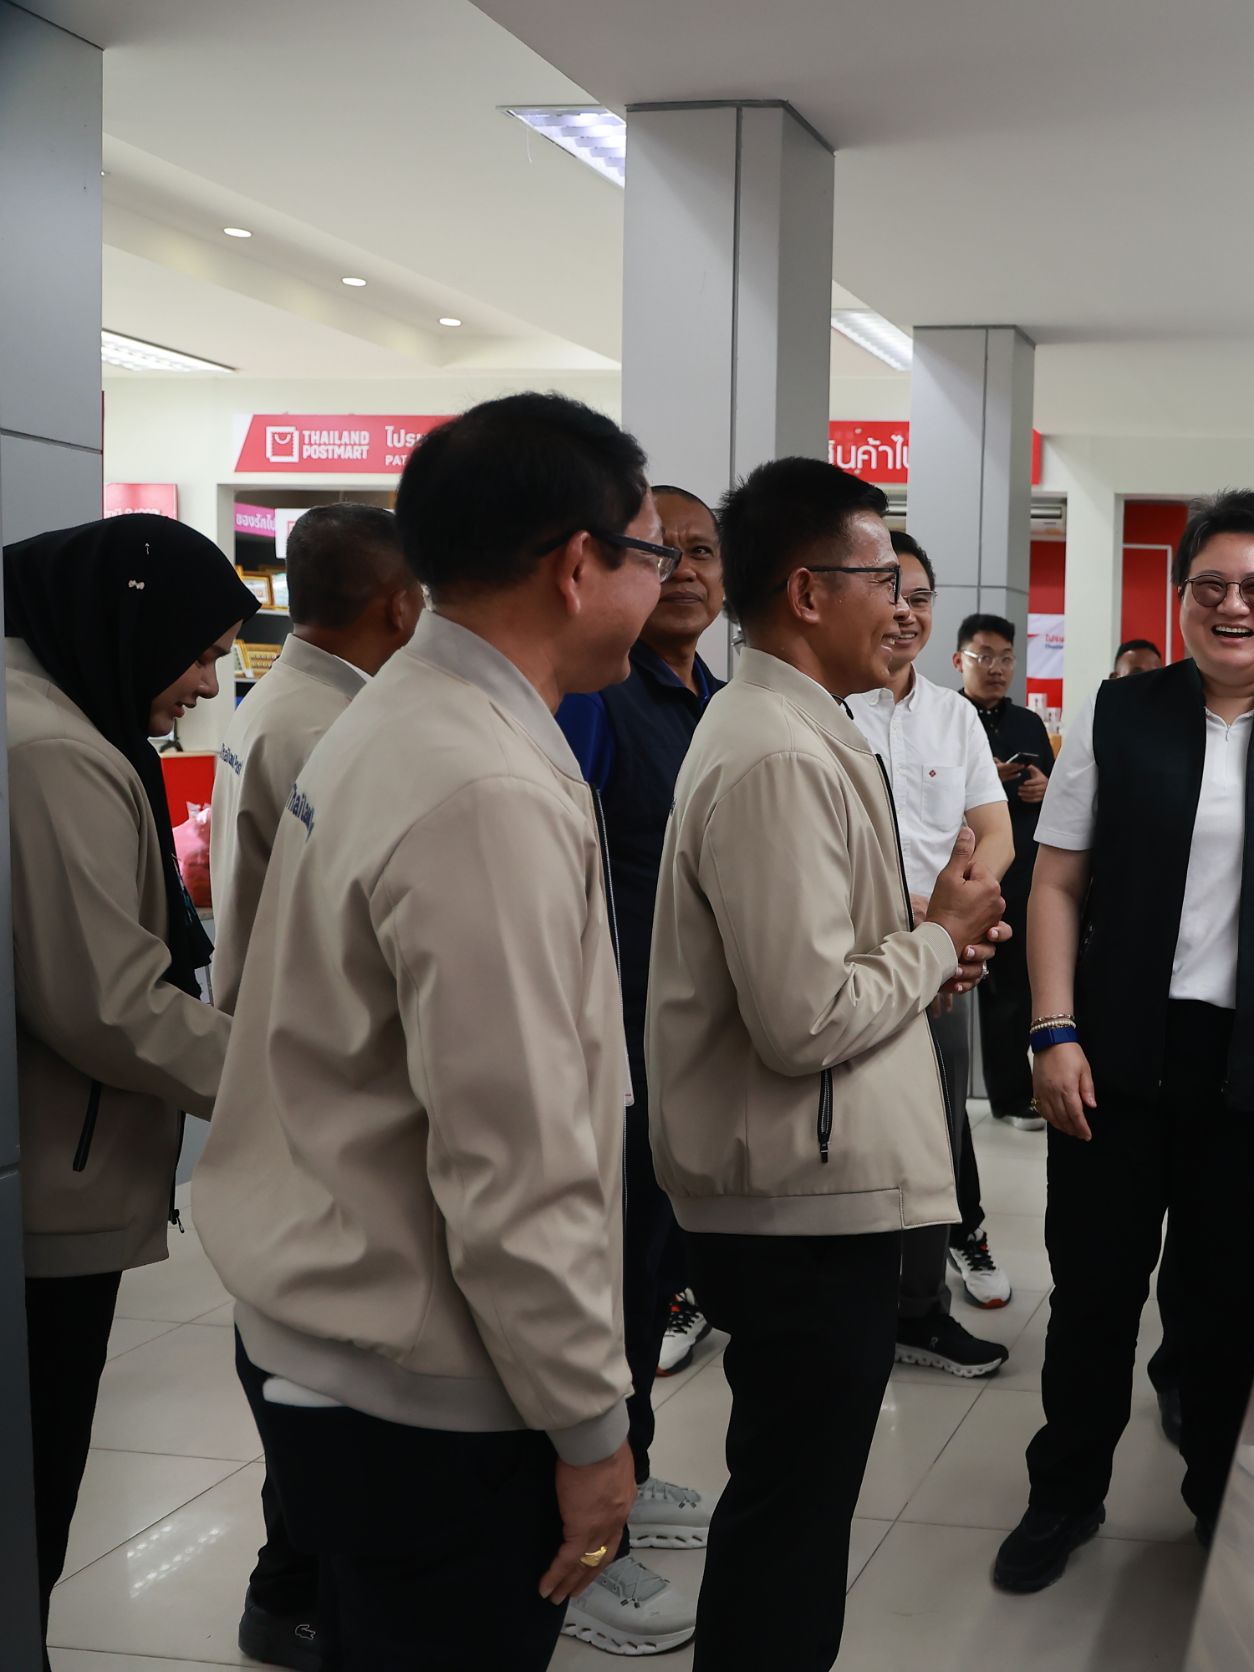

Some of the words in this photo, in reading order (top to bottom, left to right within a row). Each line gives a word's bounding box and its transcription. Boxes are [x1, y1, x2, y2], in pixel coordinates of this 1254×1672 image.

[302, 430, 370, 445] THAILAND
[385, 426, 424, 448] ไปร
[302, 446, 369, 460] POSTMART
[385, 454, 408, 466] PAT
